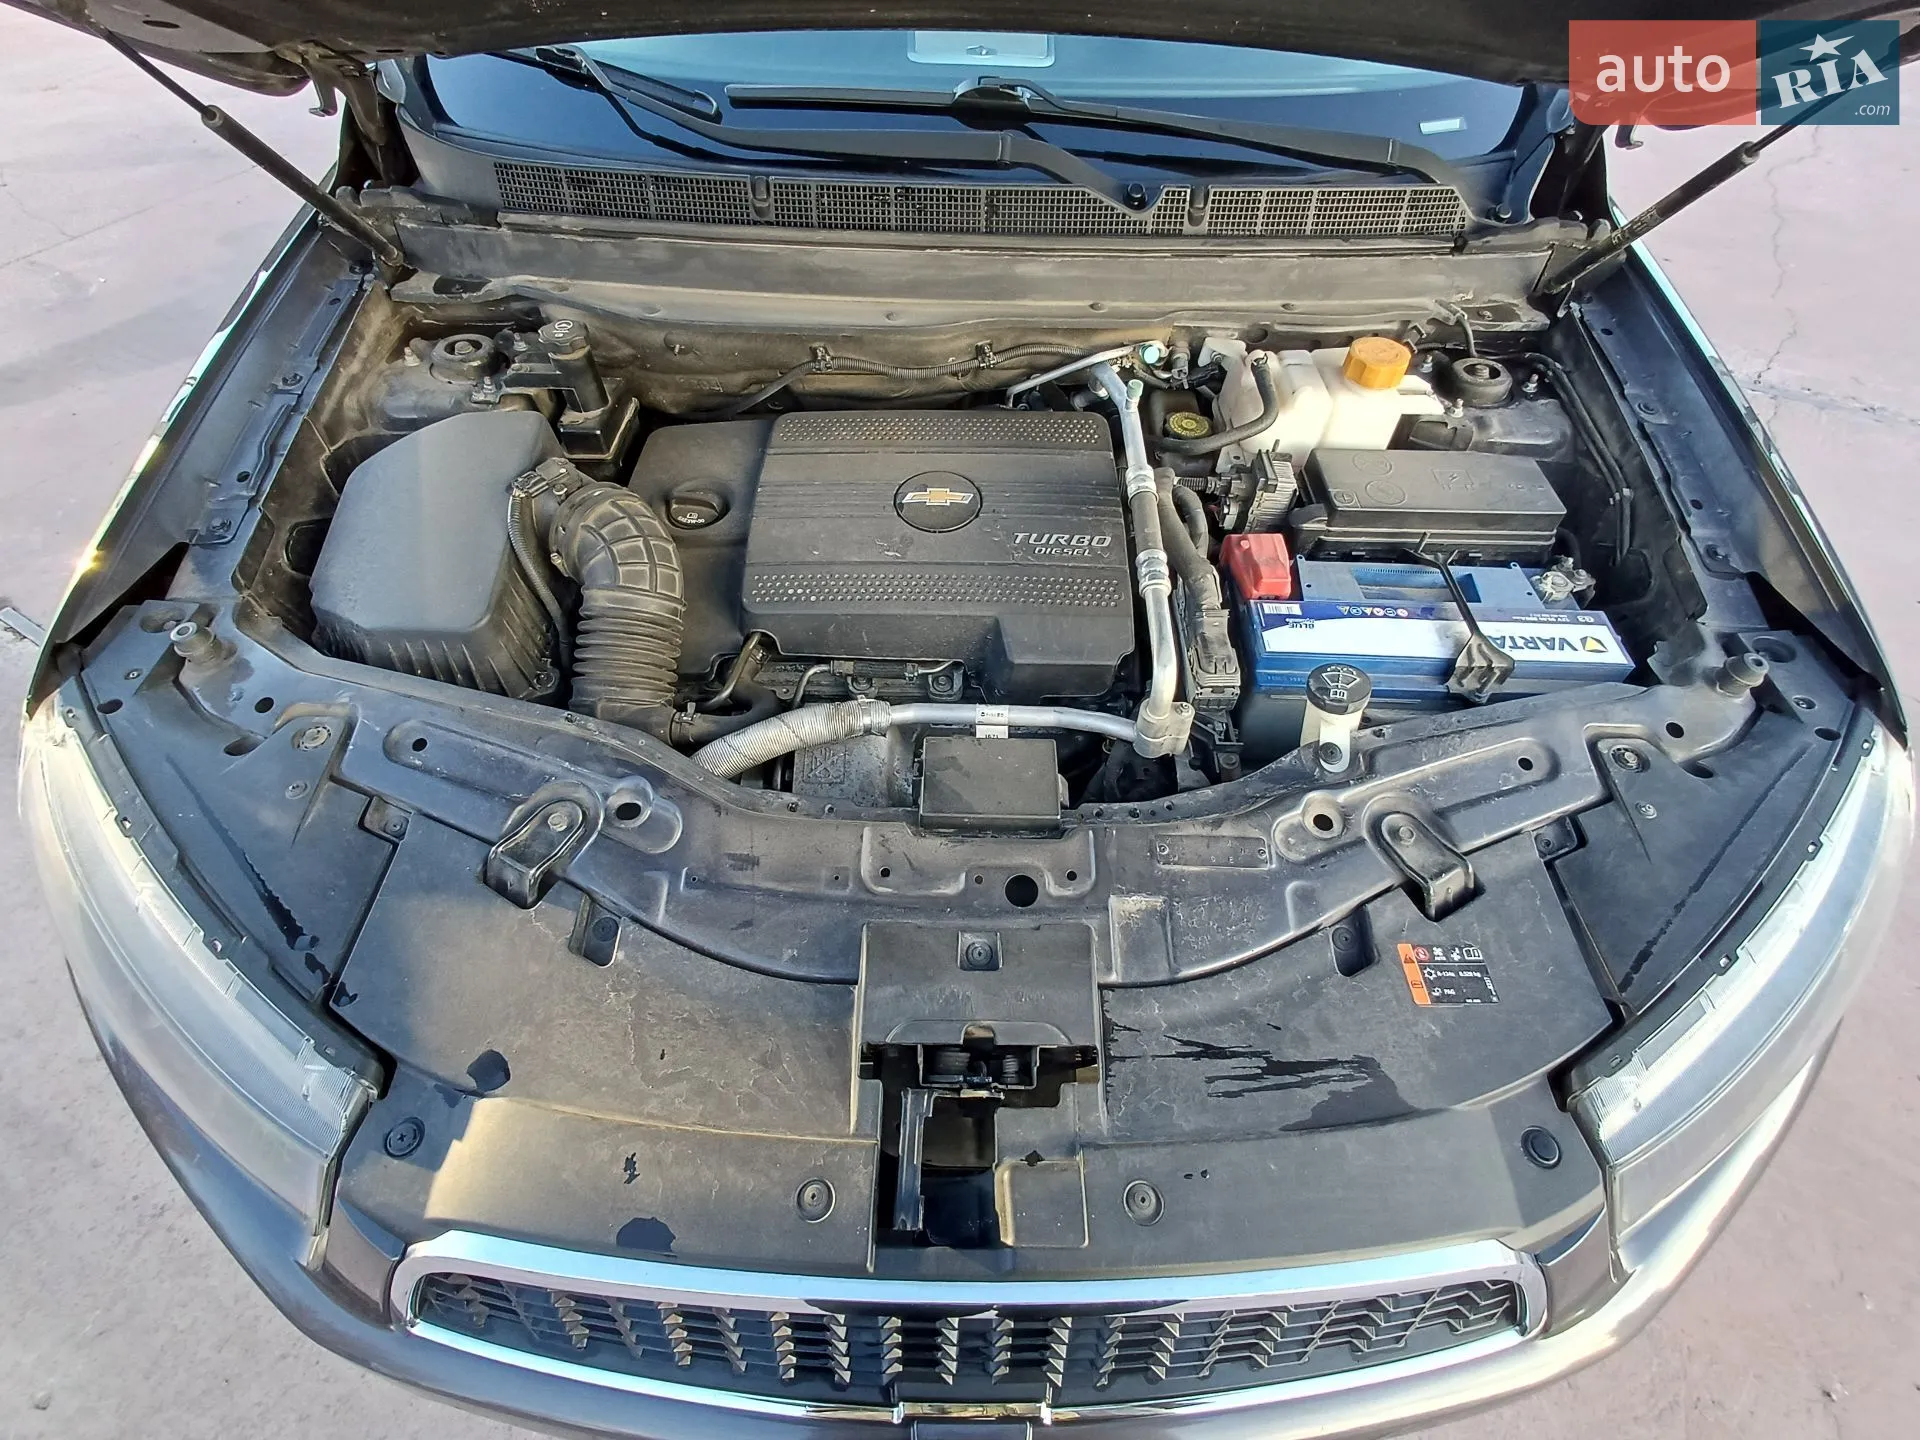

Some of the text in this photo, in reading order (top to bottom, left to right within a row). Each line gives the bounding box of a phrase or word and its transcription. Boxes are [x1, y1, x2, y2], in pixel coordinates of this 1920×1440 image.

[1013, 532, 1112, 547] TURBO
[1033, 547, 1092, 557] DIESEL
[1485, 635, 1579, 652] VARTA
